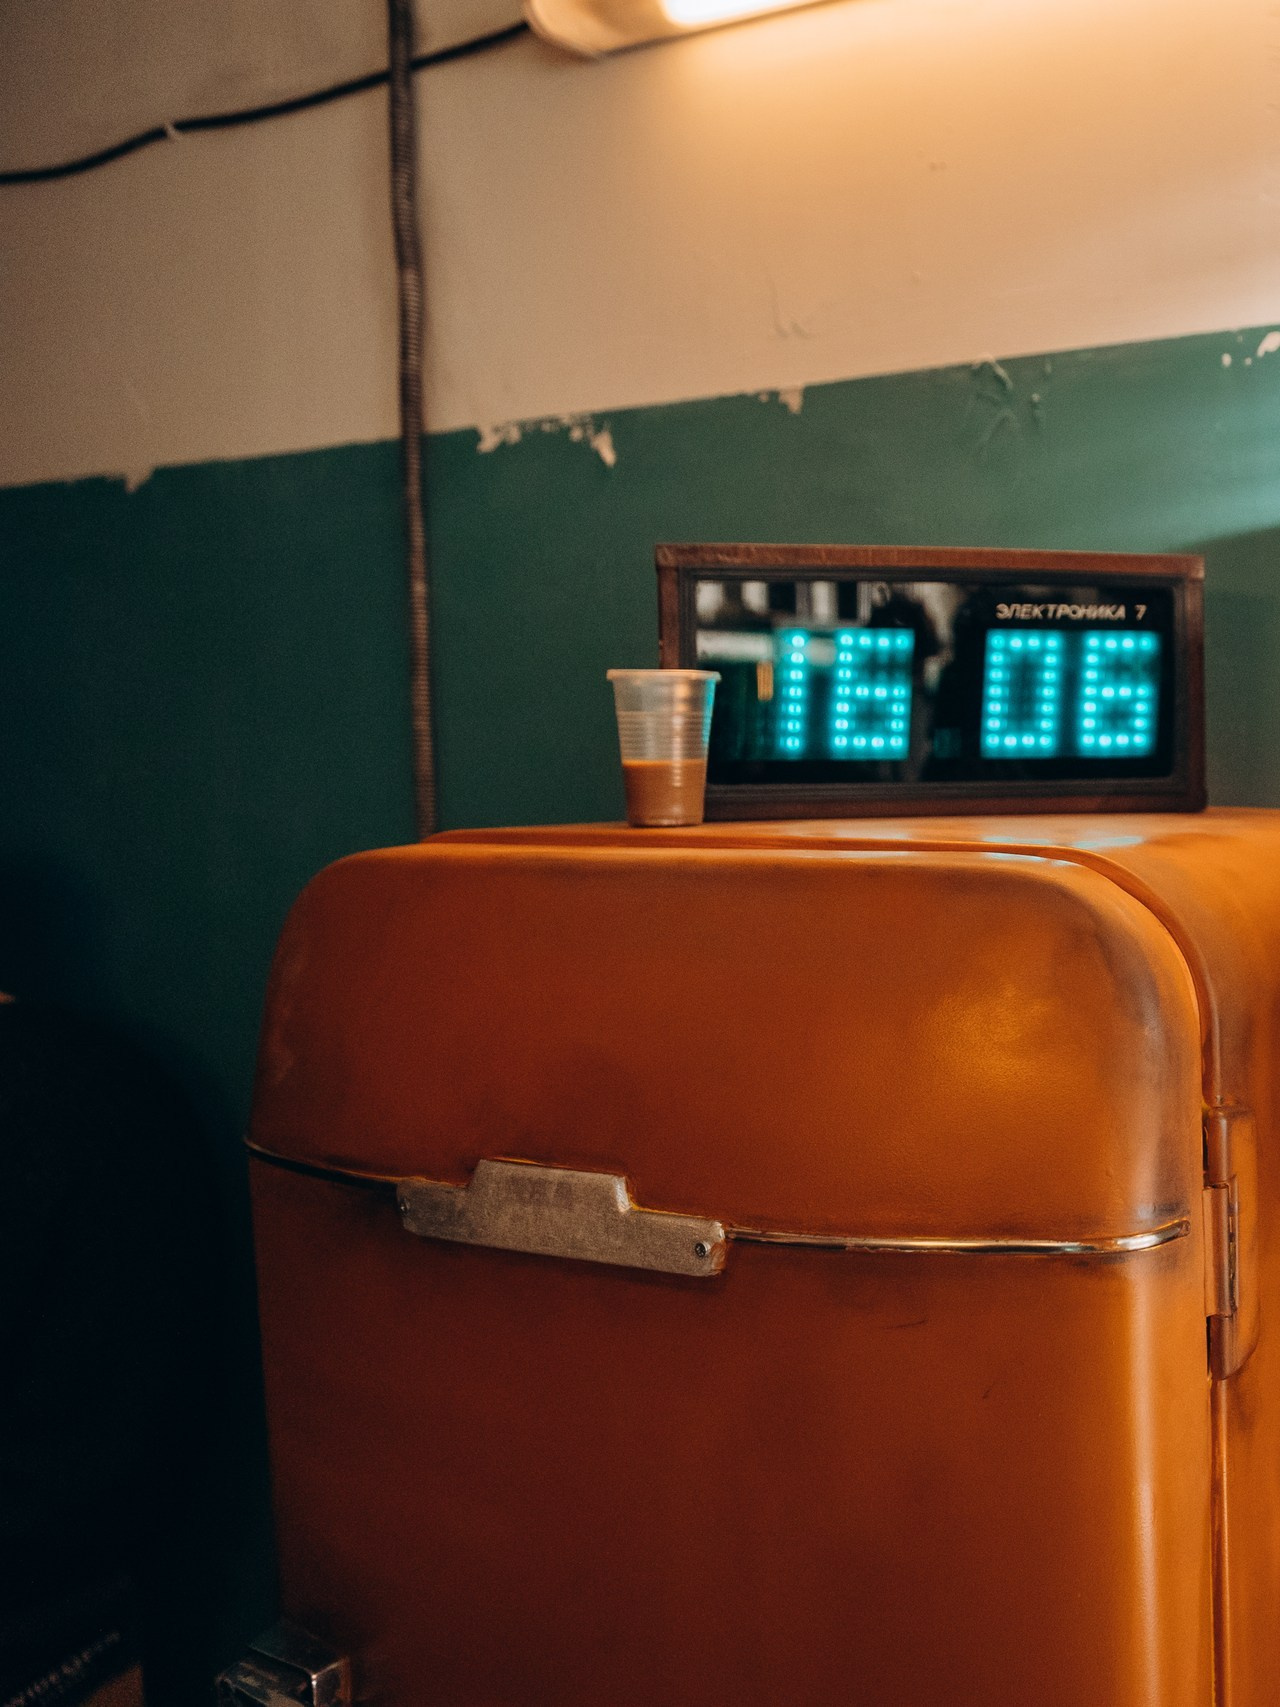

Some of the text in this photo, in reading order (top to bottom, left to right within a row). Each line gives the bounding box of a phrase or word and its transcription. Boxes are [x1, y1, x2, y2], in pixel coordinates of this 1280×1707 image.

[995, 602, 1148, 621] ЭЛЕКТРОНИКА 7
[780, 631, 1156, 756] 16 06
